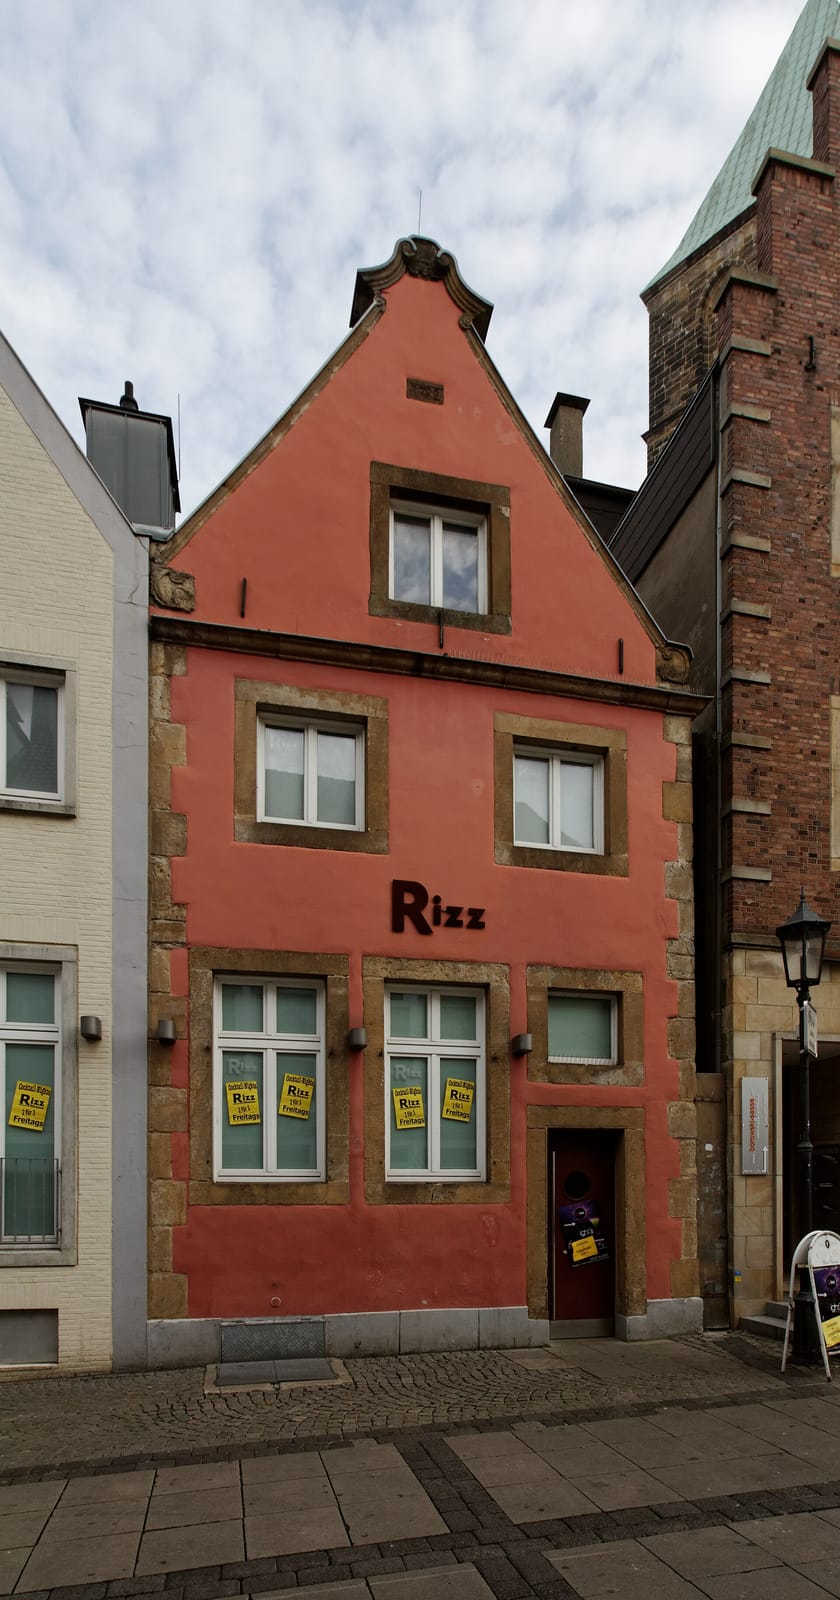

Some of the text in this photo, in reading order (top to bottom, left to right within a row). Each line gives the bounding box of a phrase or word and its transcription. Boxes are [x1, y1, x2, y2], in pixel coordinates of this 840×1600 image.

[392, 879, 486, 936] Rizz
[288, 1085, 310, 1096] Rizz
[450, 1090, 471, 1100] Rizz
[20, 1094, 45, 1106] Rizz
[233, 1093, 256, 1104] Rizz
[400, 1098, 421, 1108] Rizz
[283, 1105, 309, 1115] Freitags
[446, 1109, 470, 1118] Freitags
[13, 1115, 44, 1127] Freitags
